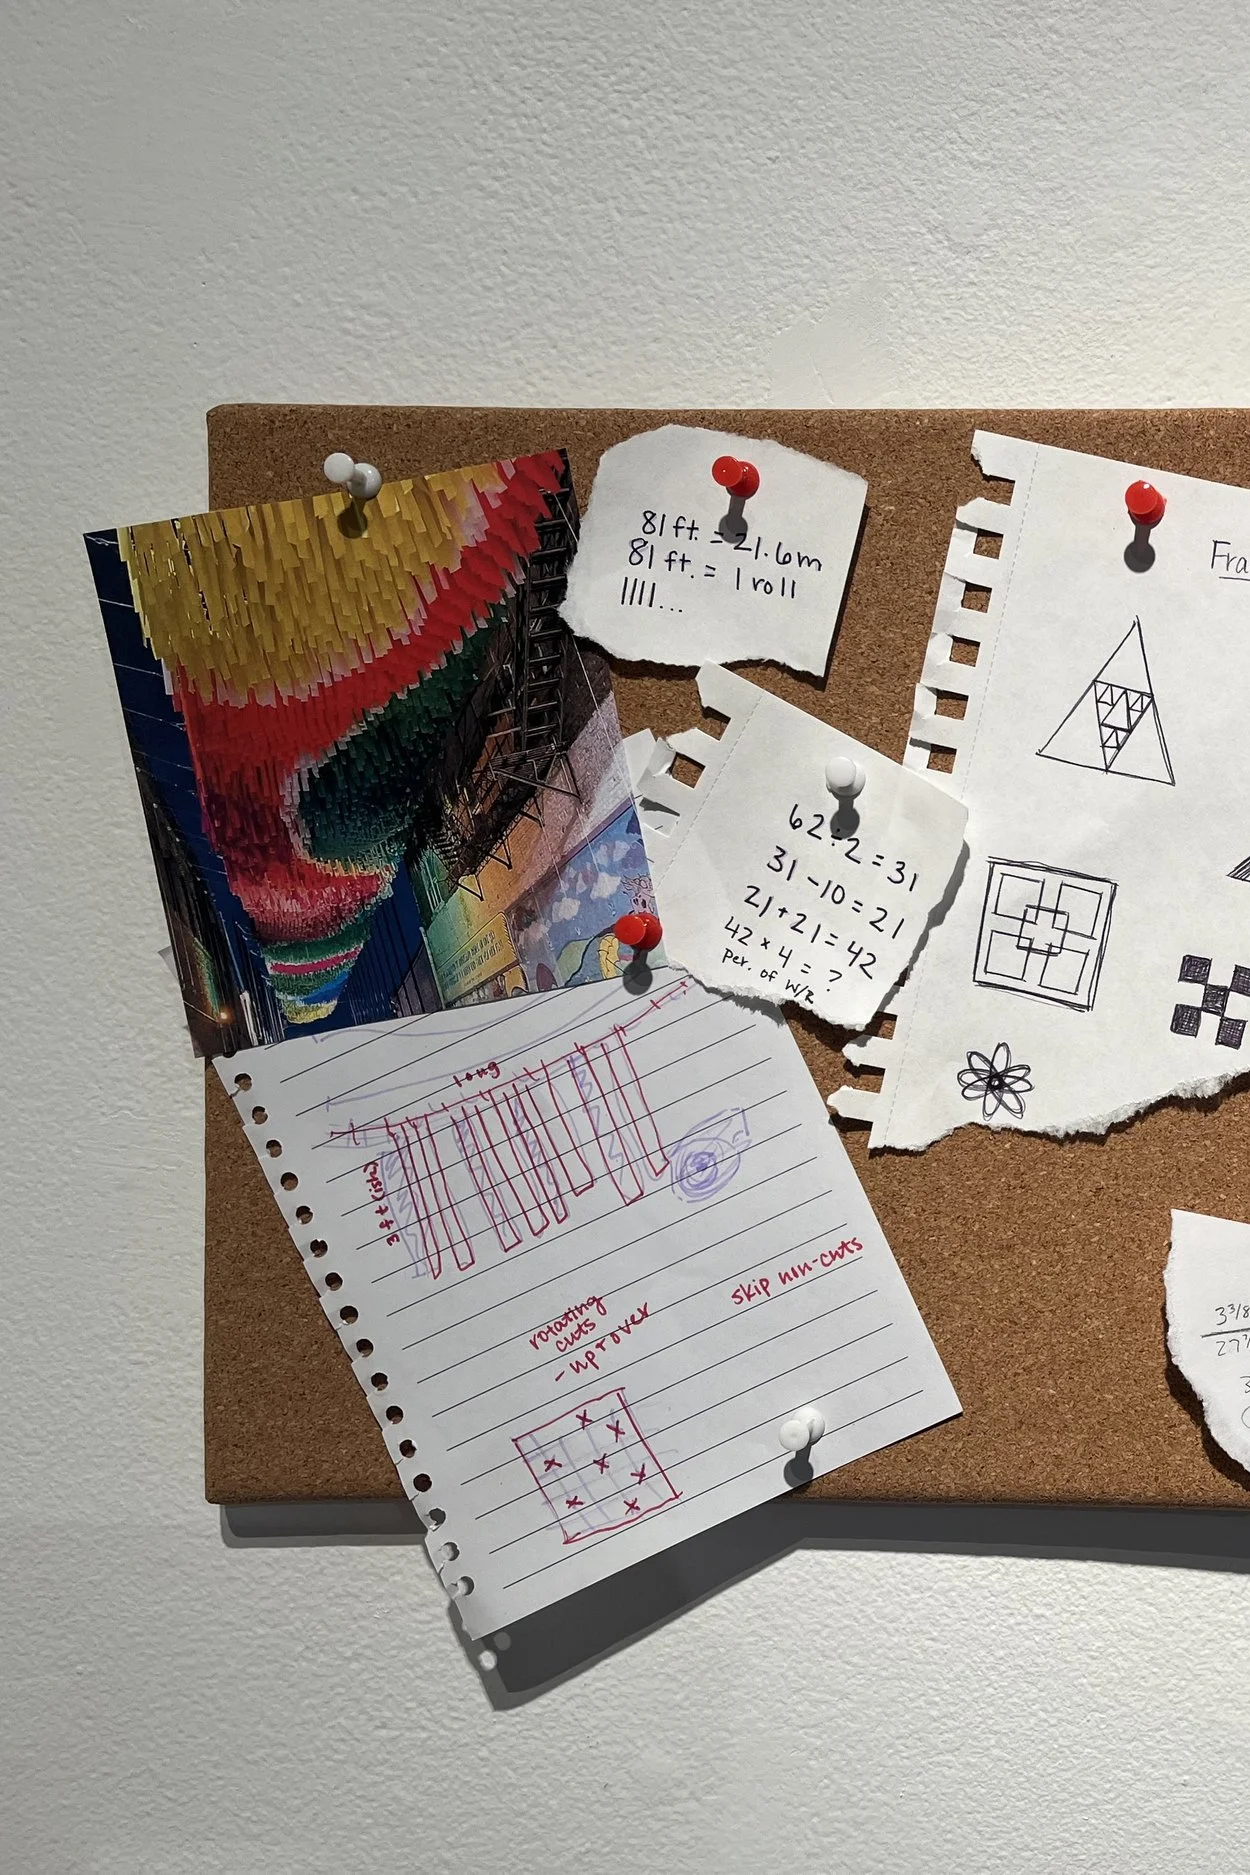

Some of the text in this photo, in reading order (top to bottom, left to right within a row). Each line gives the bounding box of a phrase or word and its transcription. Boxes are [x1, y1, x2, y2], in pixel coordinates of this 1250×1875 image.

[642, 510, 666, 537] 81
[628, 538, 654, 569] 81
[664, 551, 695, 579] ft.
[752, 577, 796, 599] roll
[789, 804, 824, 841] 62
[887, 861, 919, 892] 31
[766, 845, 796, 881] 31
[869, 907, 905, 939] 21
[724, 916, 753, 946] 42
[778, 945, 793, 968] 4
[826, 969, 843, 992] ?
[744, 885, 774, 917] 21
[790, 913, 821, 943] 21
[847, 941, 877, 980] 42
[760, 969, 778, 982] of
[453, 1061, 500, 1088] long
[386, 1233, 400, 1246] 3
[731, 1278, 771, 1305] skip
[529, 1296, 607, 1350] rotating
[556, 1318, 596, 1352] cuts
[569, 1350, 599, 1374] up
[610, 1302, 649, 1344] over
